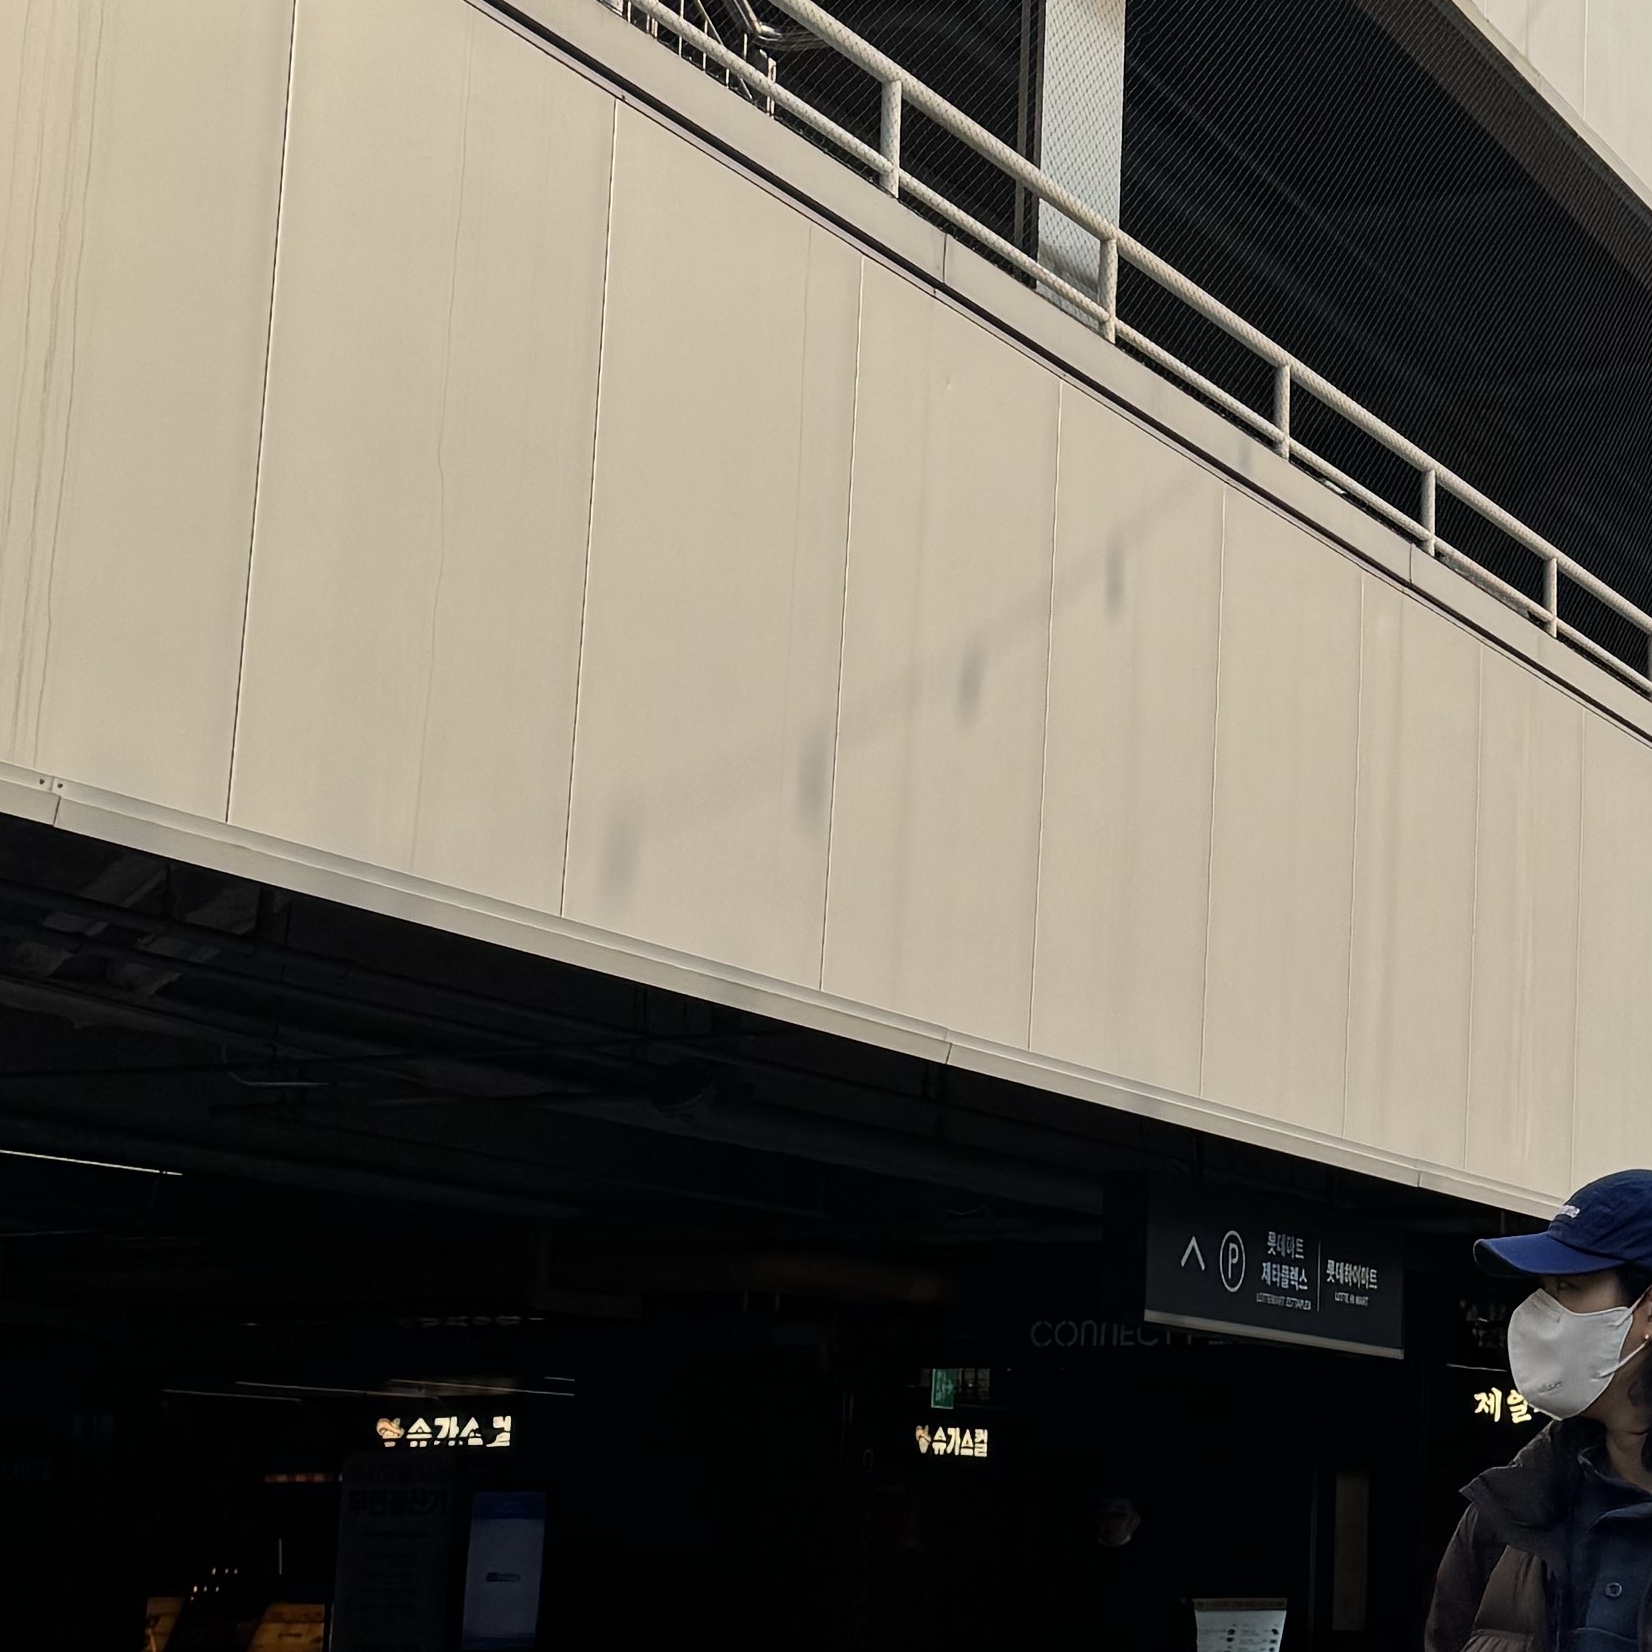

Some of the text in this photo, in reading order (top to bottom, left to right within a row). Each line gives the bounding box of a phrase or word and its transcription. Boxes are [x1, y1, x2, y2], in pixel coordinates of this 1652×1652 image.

[1267, 1231, 1305, 1260] 롯데마트
[1260, 1262, 1309, 1291] 제타플렉스
[1326, 1259, 1379, 1290] 롯데하이마트
[1473, 1386, 1538, 1424] 제일
